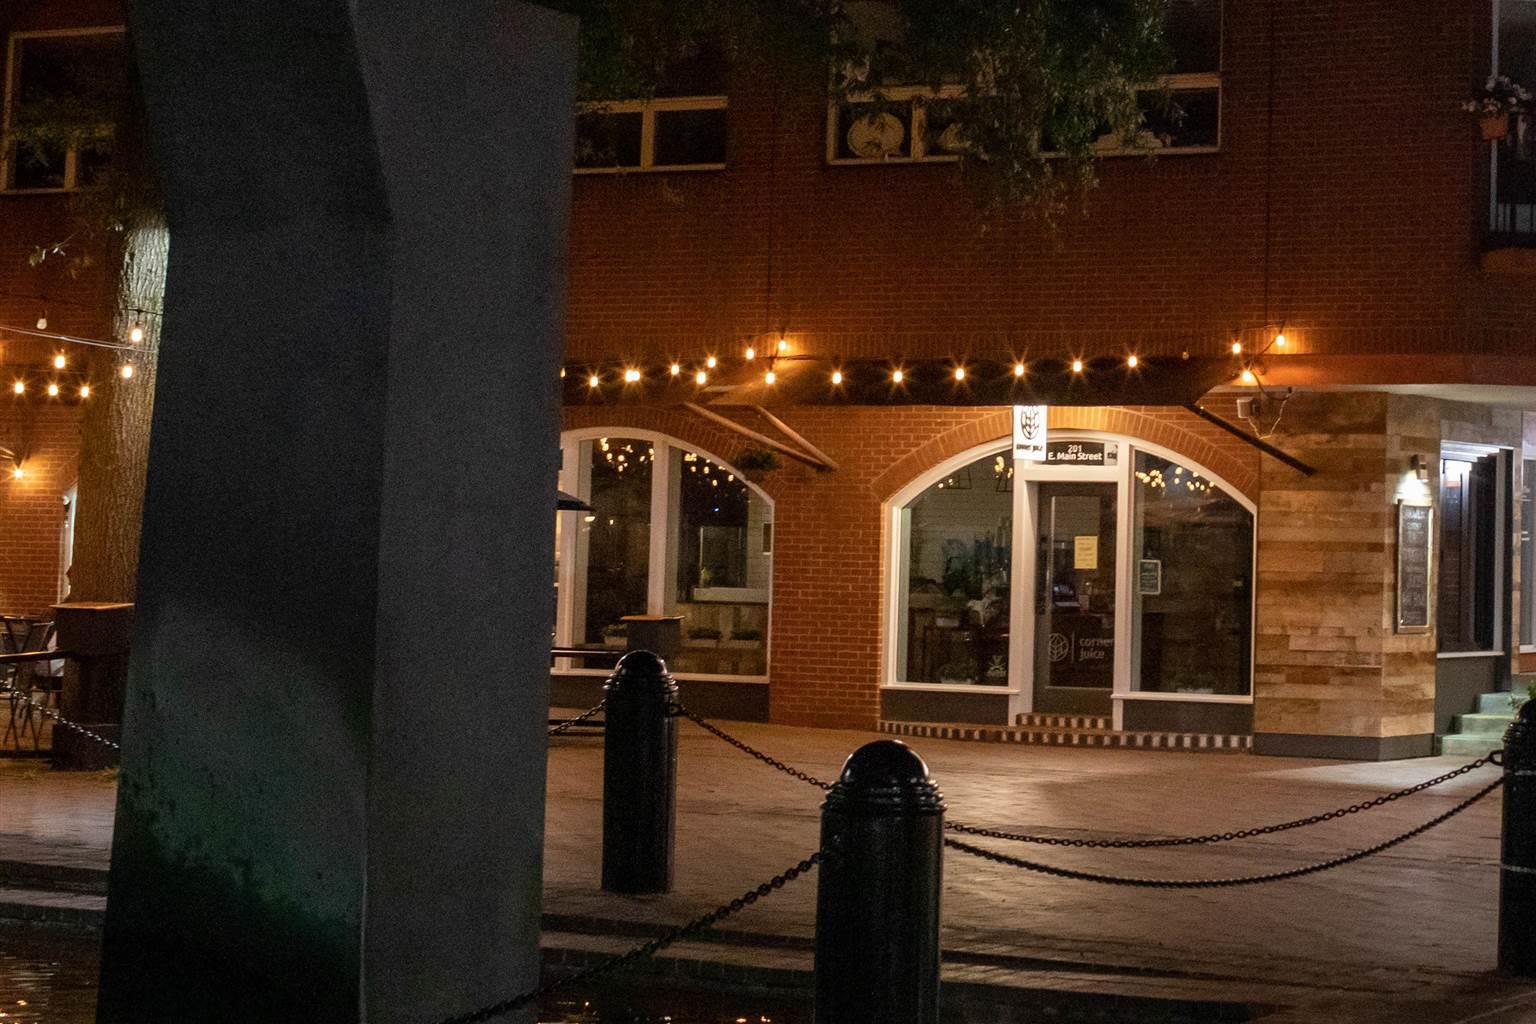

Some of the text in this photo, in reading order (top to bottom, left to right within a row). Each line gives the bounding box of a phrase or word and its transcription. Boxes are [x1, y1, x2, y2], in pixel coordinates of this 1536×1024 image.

[1068, 444, 1082, 454] 201
[1057, 451, 1076, 461] Main
[1077, 451, 1102, 461] Street
